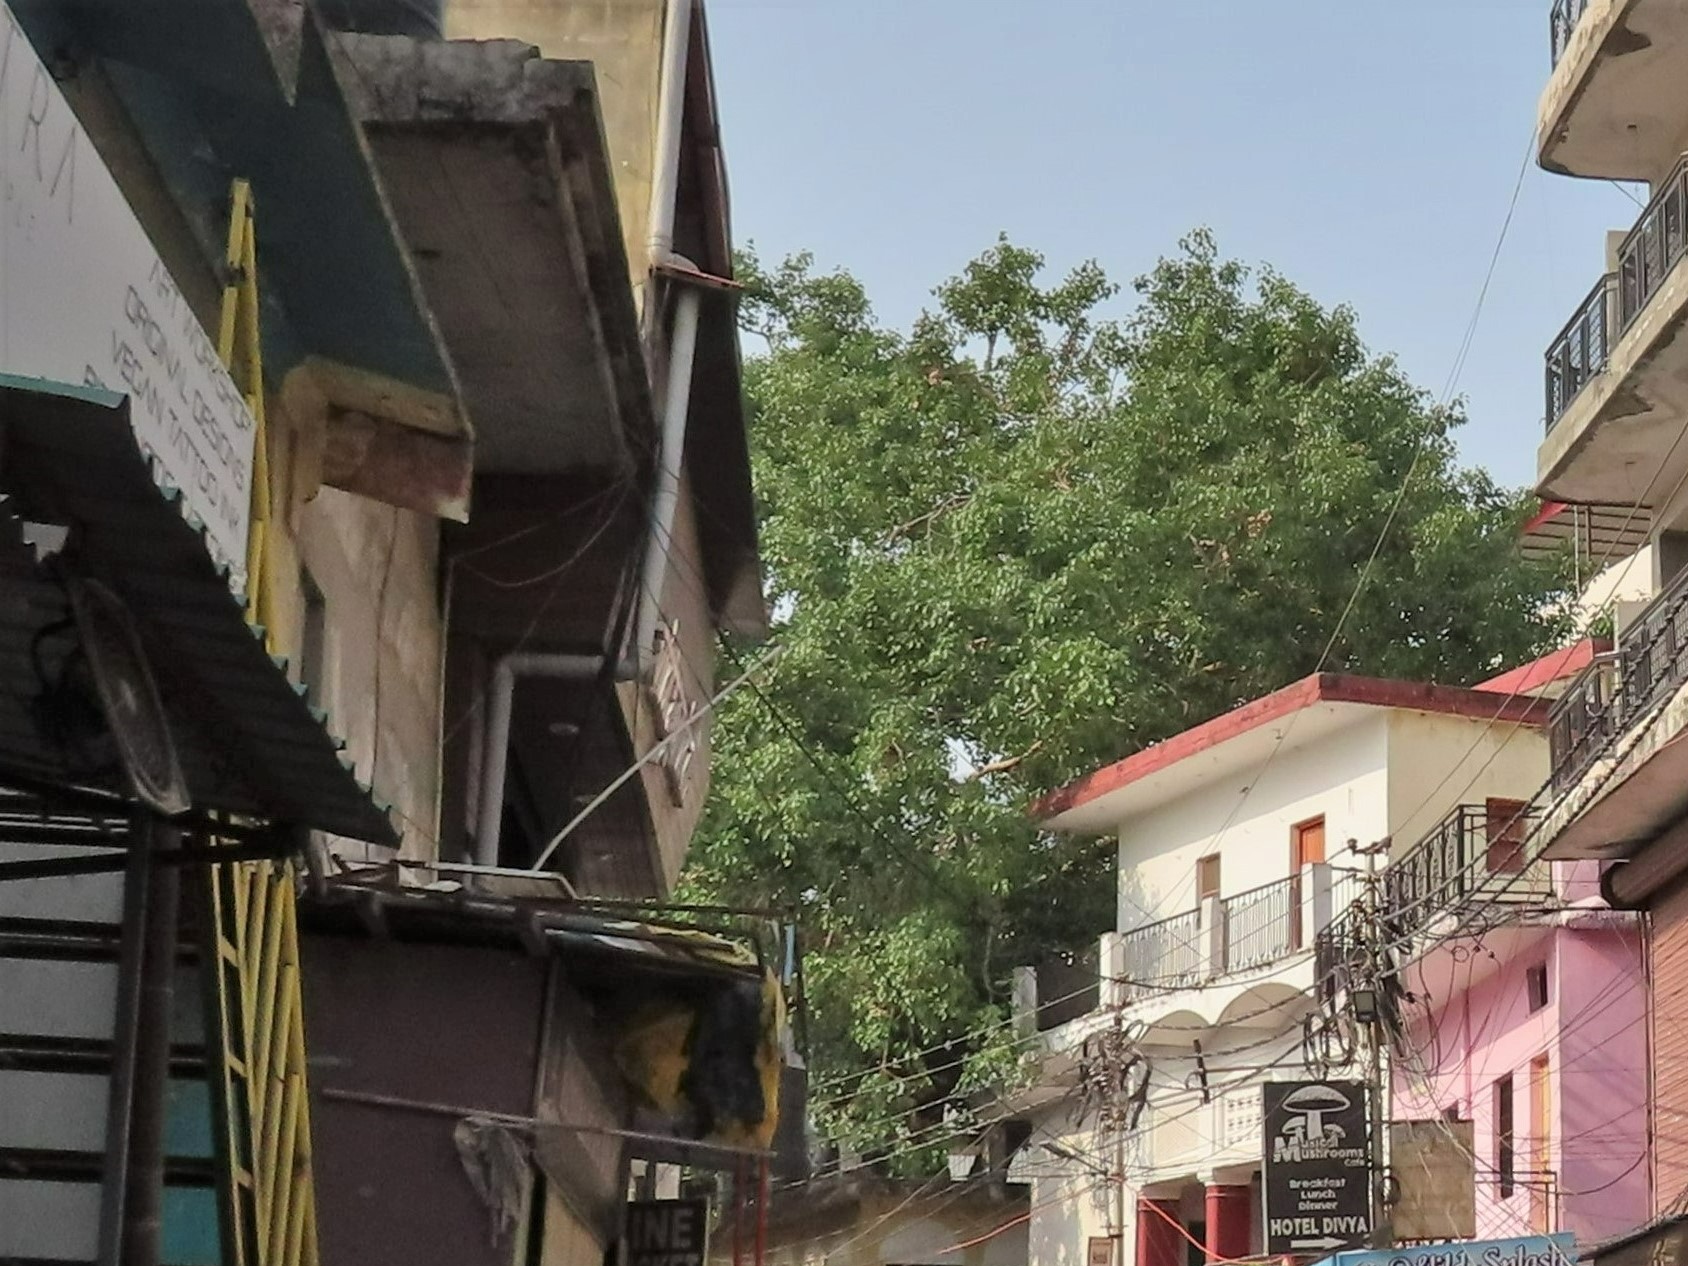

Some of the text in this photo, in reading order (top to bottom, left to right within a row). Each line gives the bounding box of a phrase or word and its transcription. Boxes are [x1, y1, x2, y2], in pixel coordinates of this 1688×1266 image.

[1300, 1189, 1337, 1201] Lunch
[1271, 1216, 1369, 1237] HOTEL DIVYA
